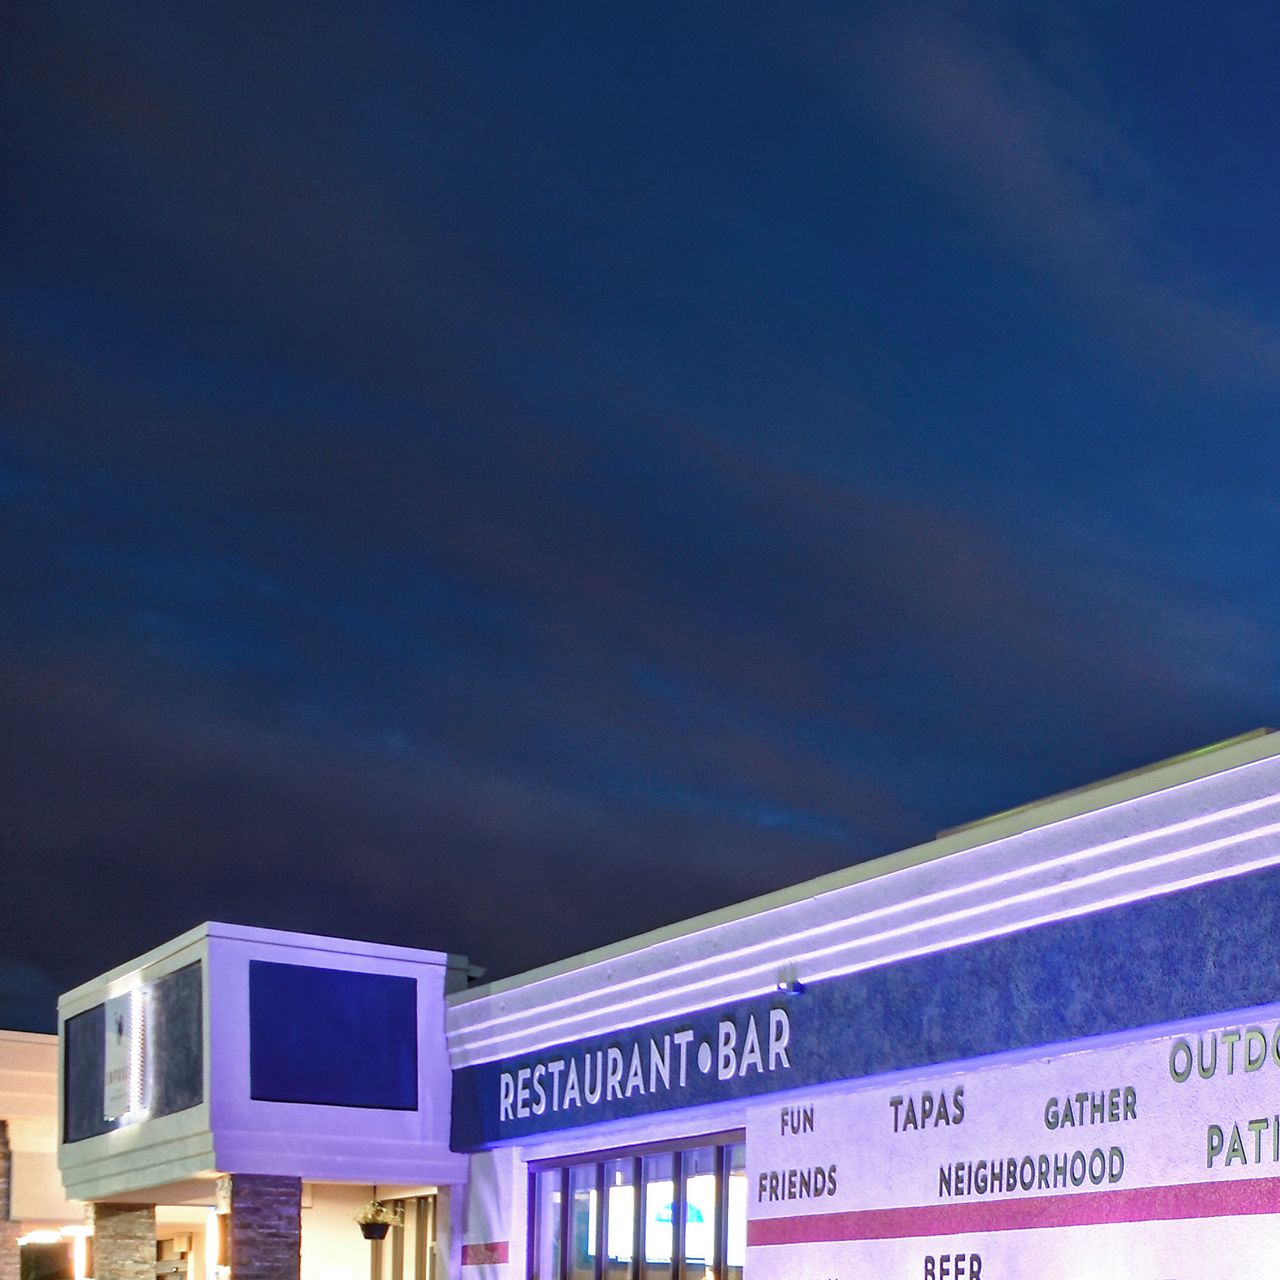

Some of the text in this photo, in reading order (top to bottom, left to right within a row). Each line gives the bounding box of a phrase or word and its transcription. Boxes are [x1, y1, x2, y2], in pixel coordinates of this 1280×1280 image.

[500, 1008, 791, 1121] RESTAURANT BAR
[780, 1104, 814, 1136] FUN
[889, 1085, 965, 1133] TAPAS
[1044, 1085, 1137, 1130] GATHER
[758, 1164, 837, 1202] FRIENDS
[939, 1146, 1125, 1197] NEIGHBORHOOD
